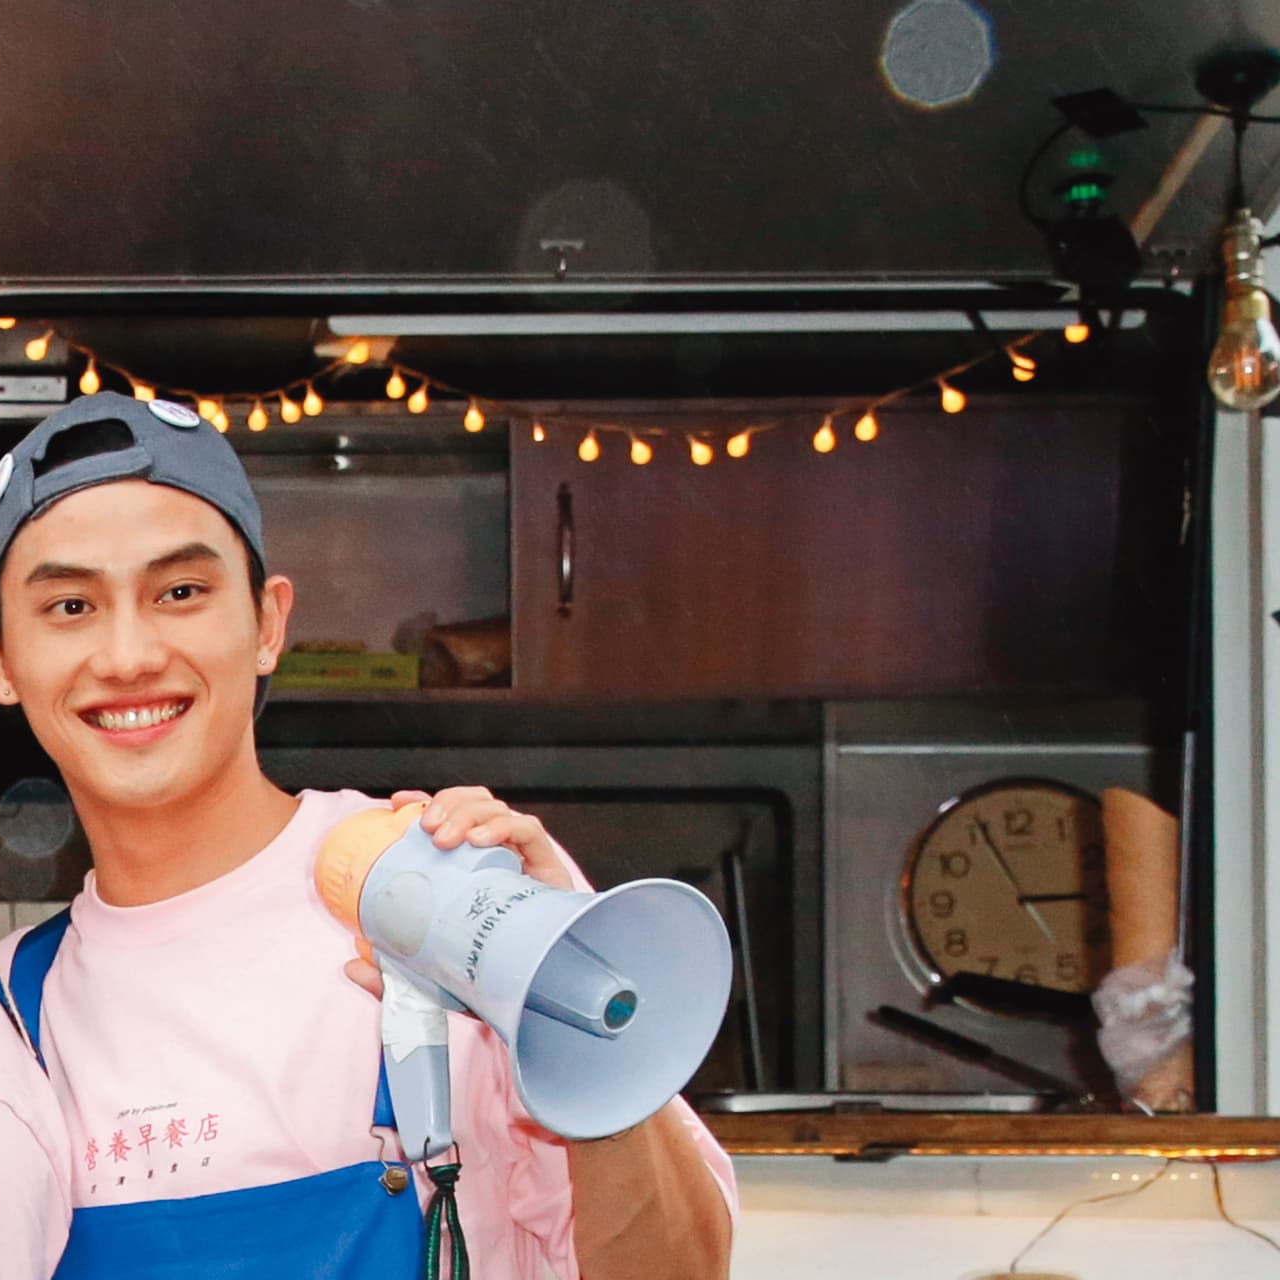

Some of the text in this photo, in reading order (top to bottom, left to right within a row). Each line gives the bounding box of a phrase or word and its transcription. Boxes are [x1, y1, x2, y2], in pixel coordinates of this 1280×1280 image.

[84, 1113, 219, 1172] 營養早餐店
